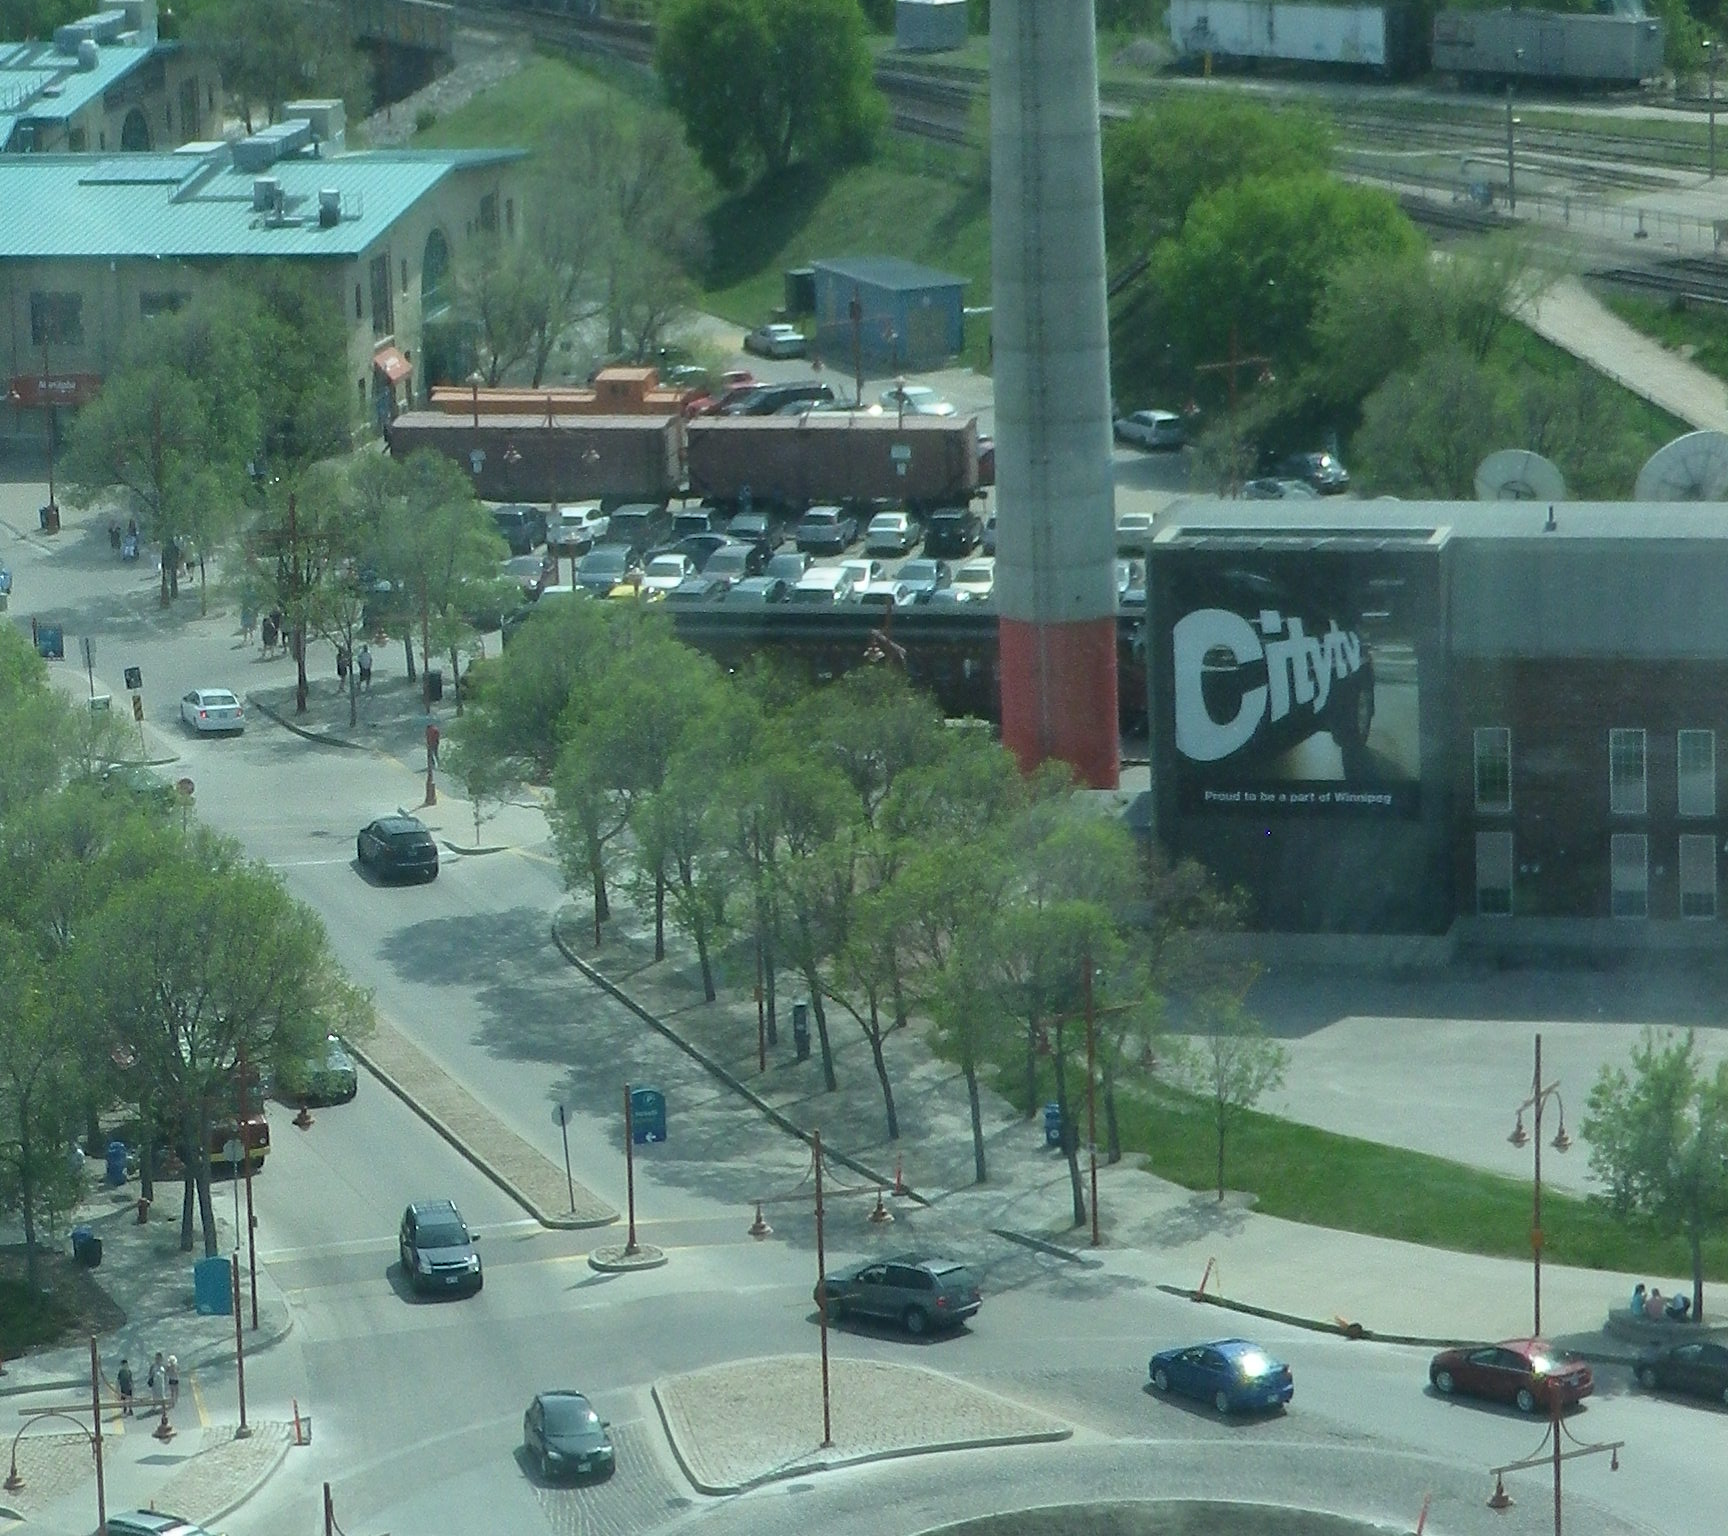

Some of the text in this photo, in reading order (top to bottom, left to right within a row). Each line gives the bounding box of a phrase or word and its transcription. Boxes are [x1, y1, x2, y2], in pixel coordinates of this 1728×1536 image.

[1172, 608, 1361, 762] Citytv
[1204, 791, 1392, 805] Proud to be a part of Winnipeg
